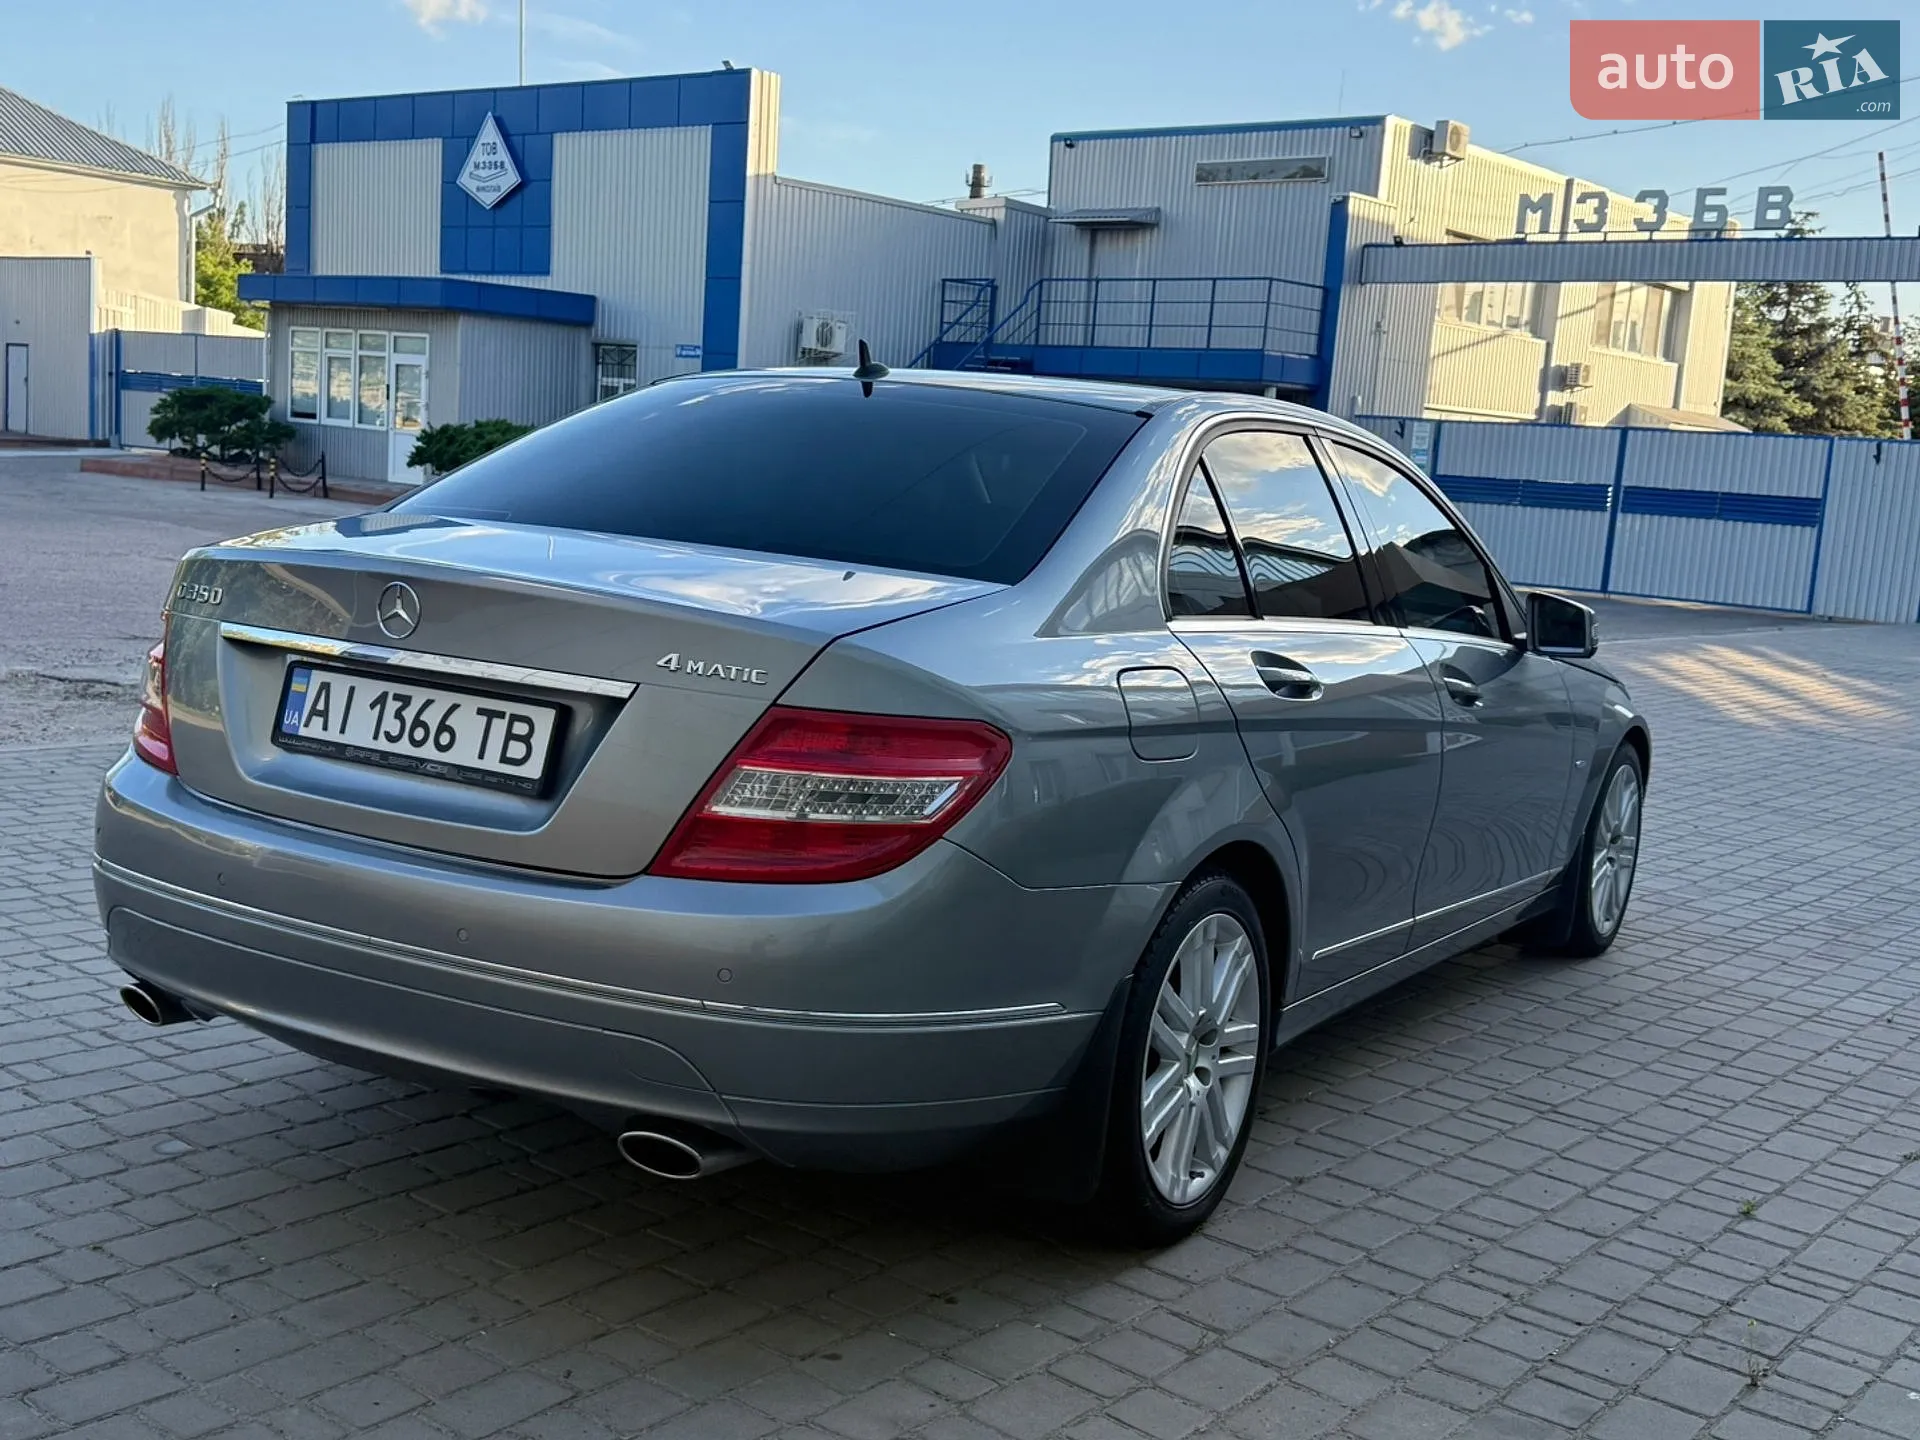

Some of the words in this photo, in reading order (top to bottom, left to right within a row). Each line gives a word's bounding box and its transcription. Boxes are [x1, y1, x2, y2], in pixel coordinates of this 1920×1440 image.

[284, 710, 299, 726] UA
[303, 681, 356, 735] AI
[369, 690, 461, 753] 1366
[475, 706, 536, 767] TB
